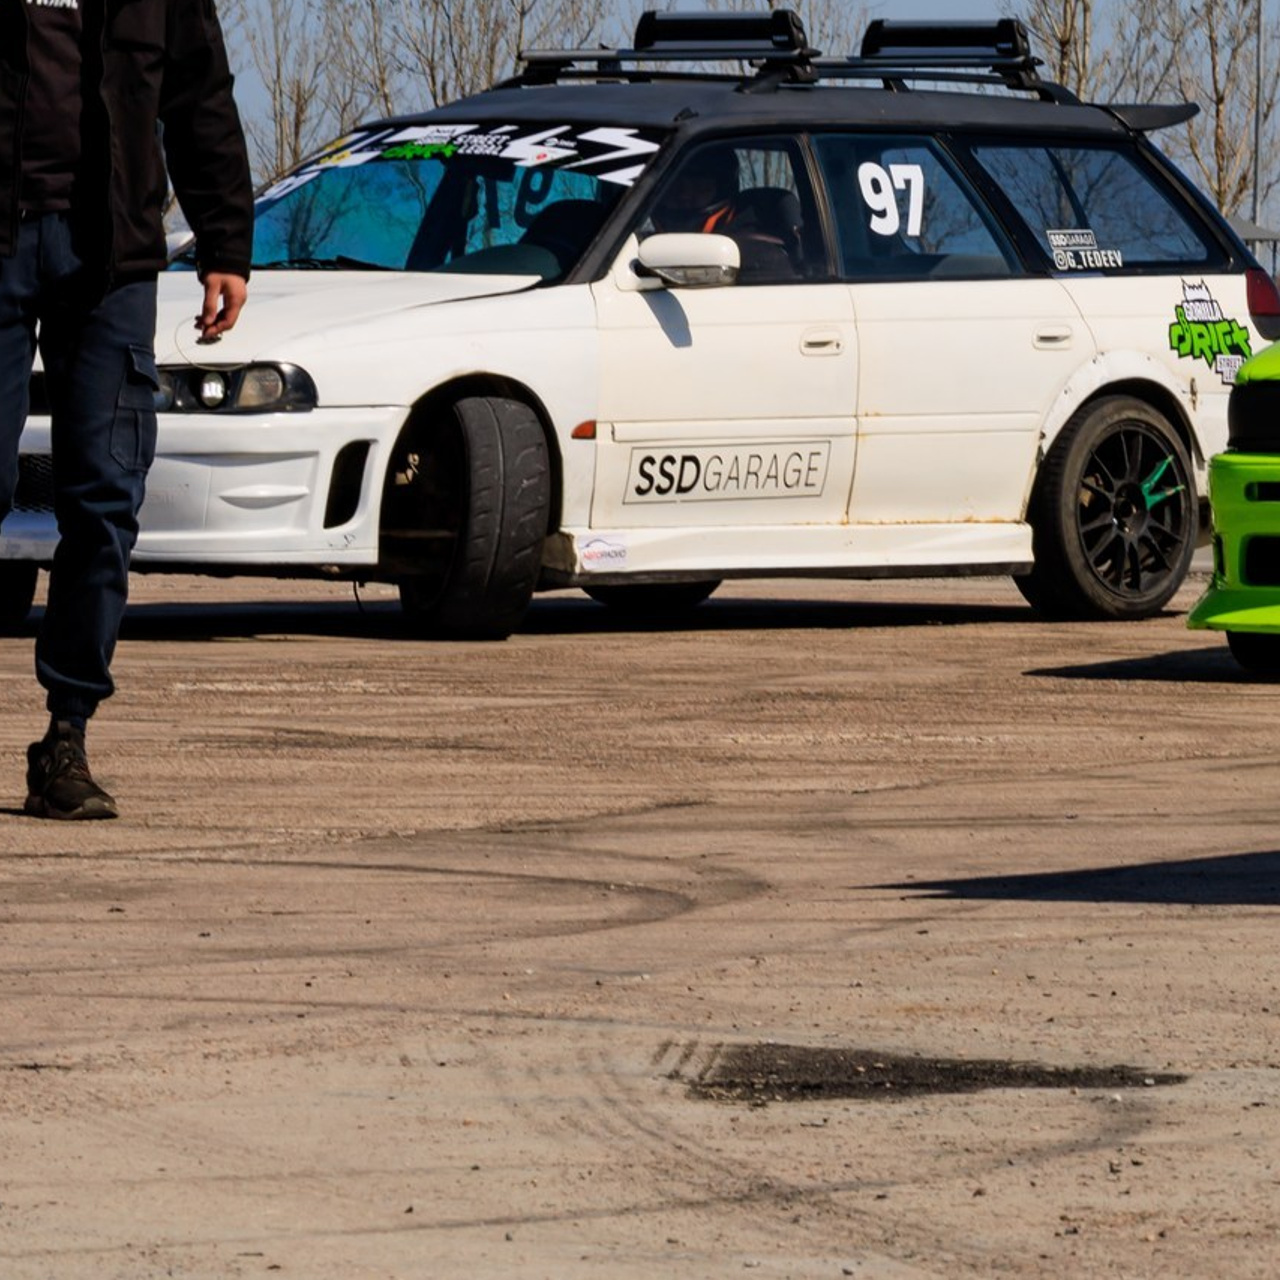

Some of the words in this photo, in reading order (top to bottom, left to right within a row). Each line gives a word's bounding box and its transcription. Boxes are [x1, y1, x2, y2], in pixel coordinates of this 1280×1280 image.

[858, 161, 924, 237] 97
[1182, 300, 1224, 322] GORILLA
[634, 451, 822, 497] SSDGARAGE
